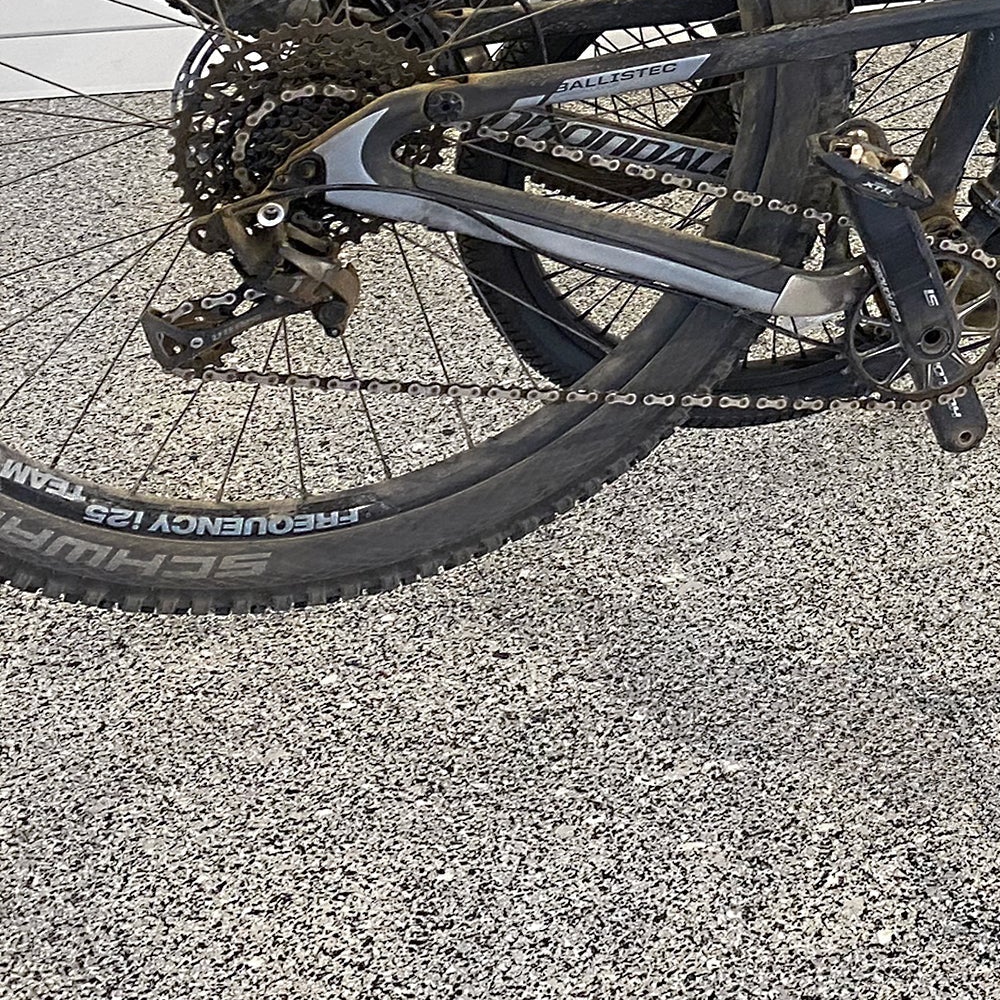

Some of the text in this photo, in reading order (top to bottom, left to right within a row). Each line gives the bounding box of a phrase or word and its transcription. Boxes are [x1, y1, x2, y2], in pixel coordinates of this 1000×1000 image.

[556, 62, 678, 93] BALLISTEC
[0, 458, 361, 537] FREQUENCY i25 TEAM
[0, 510, 272, 580] SCHWA
